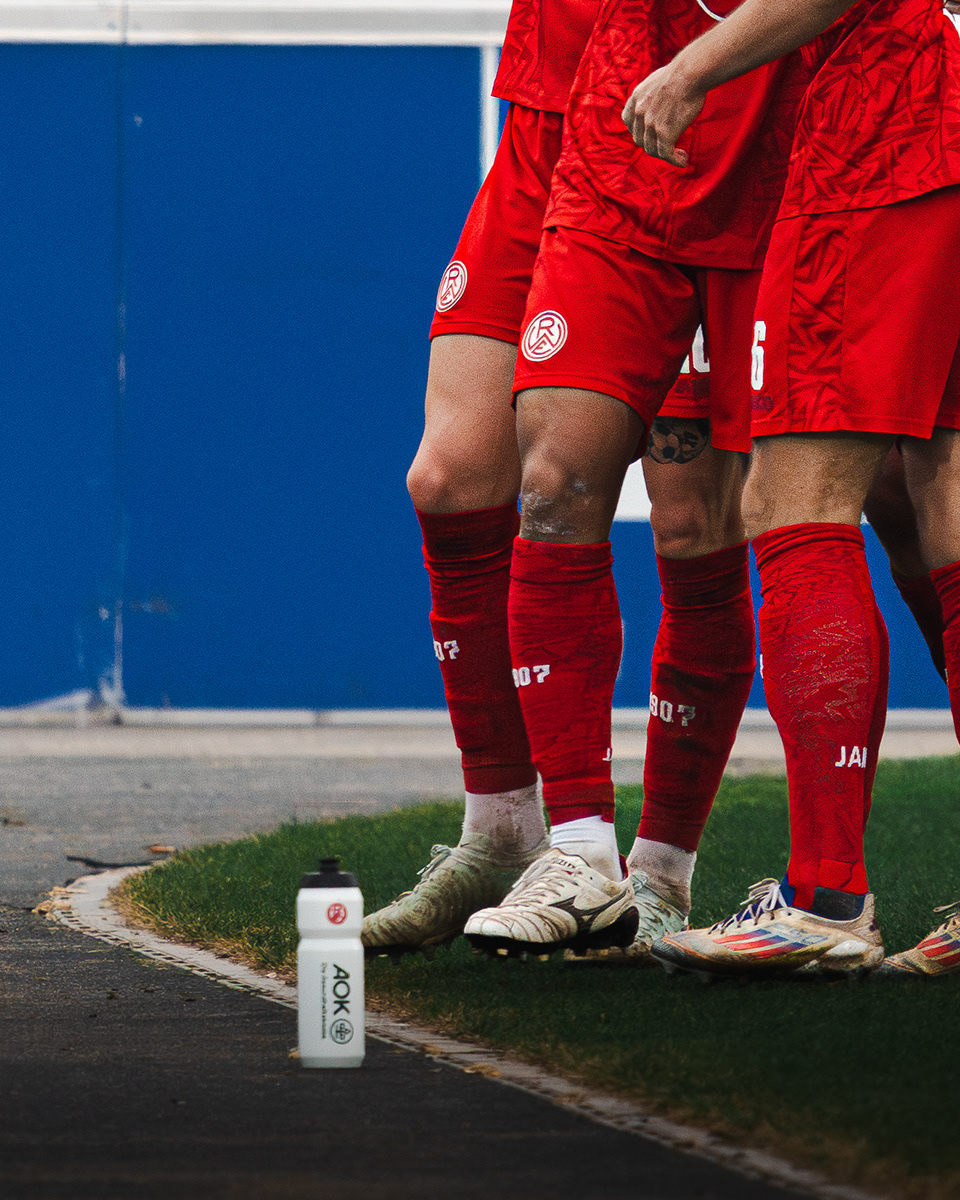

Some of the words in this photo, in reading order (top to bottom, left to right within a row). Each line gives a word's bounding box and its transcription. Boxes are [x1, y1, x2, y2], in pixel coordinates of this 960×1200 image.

[751, 321, 766, 391] 6
[650, 692, 696, 727] 907
[332, 963, 351, 1015] AOK
